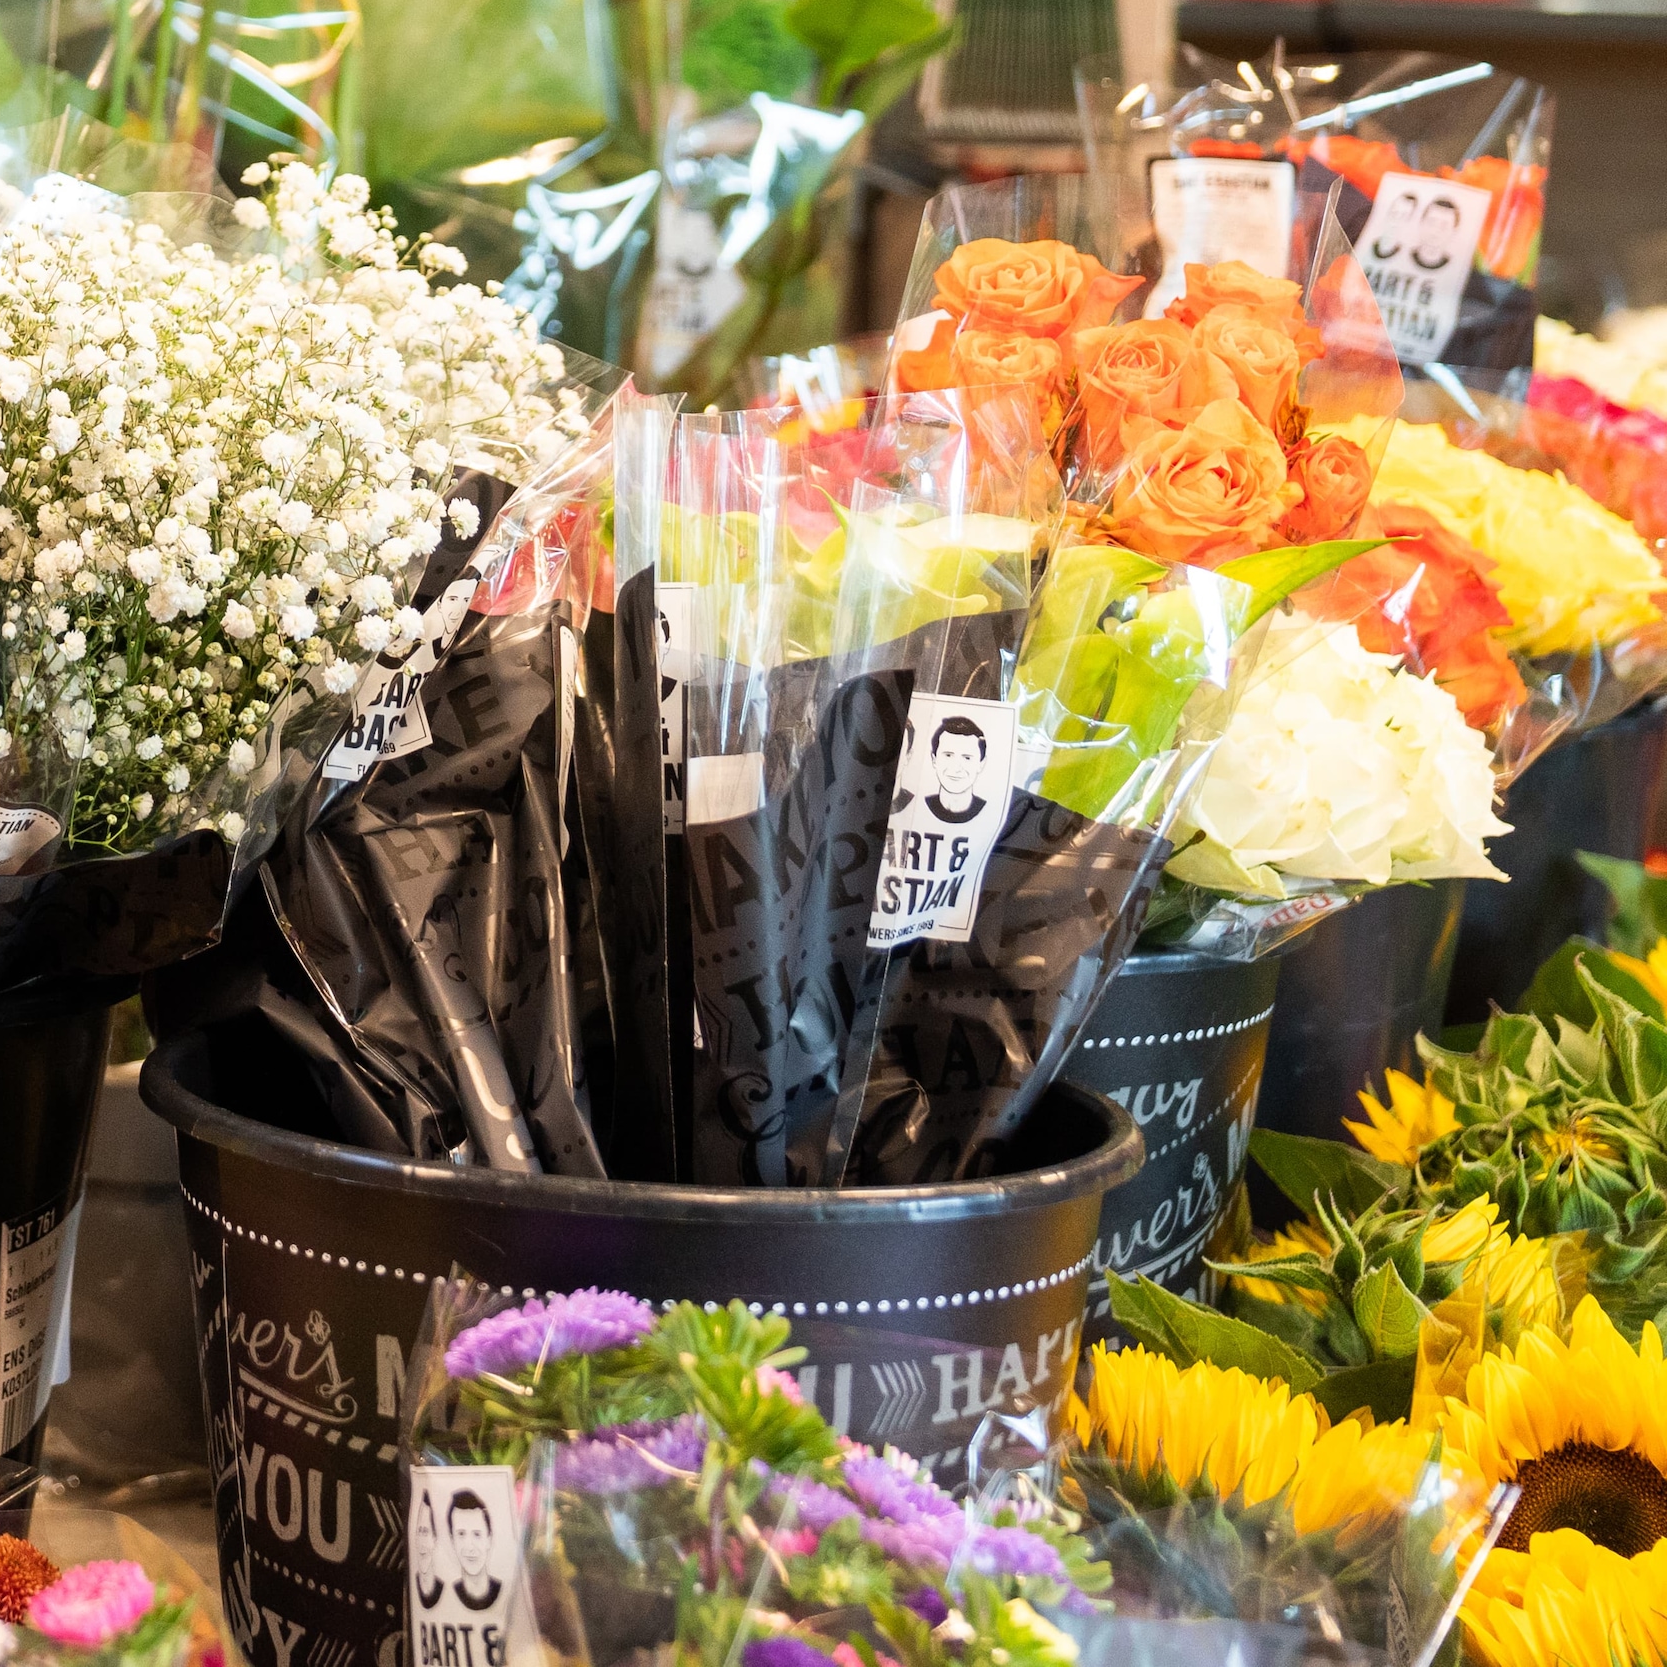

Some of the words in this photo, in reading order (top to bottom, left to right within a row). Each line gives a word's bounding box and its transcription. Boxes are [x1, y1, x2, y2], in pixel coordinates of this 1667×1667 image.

[948, 836, 969, 873] &
[873, 874, 966, 916] STIAN
[8, 1221, 34, 1252] TST
[37, 1207, 56, 1239] 761
[3, 1345, 25, 1373] ENS
[240, 1442, 352, 1564] YOU
[419, 1622, 476, 1667] BART
